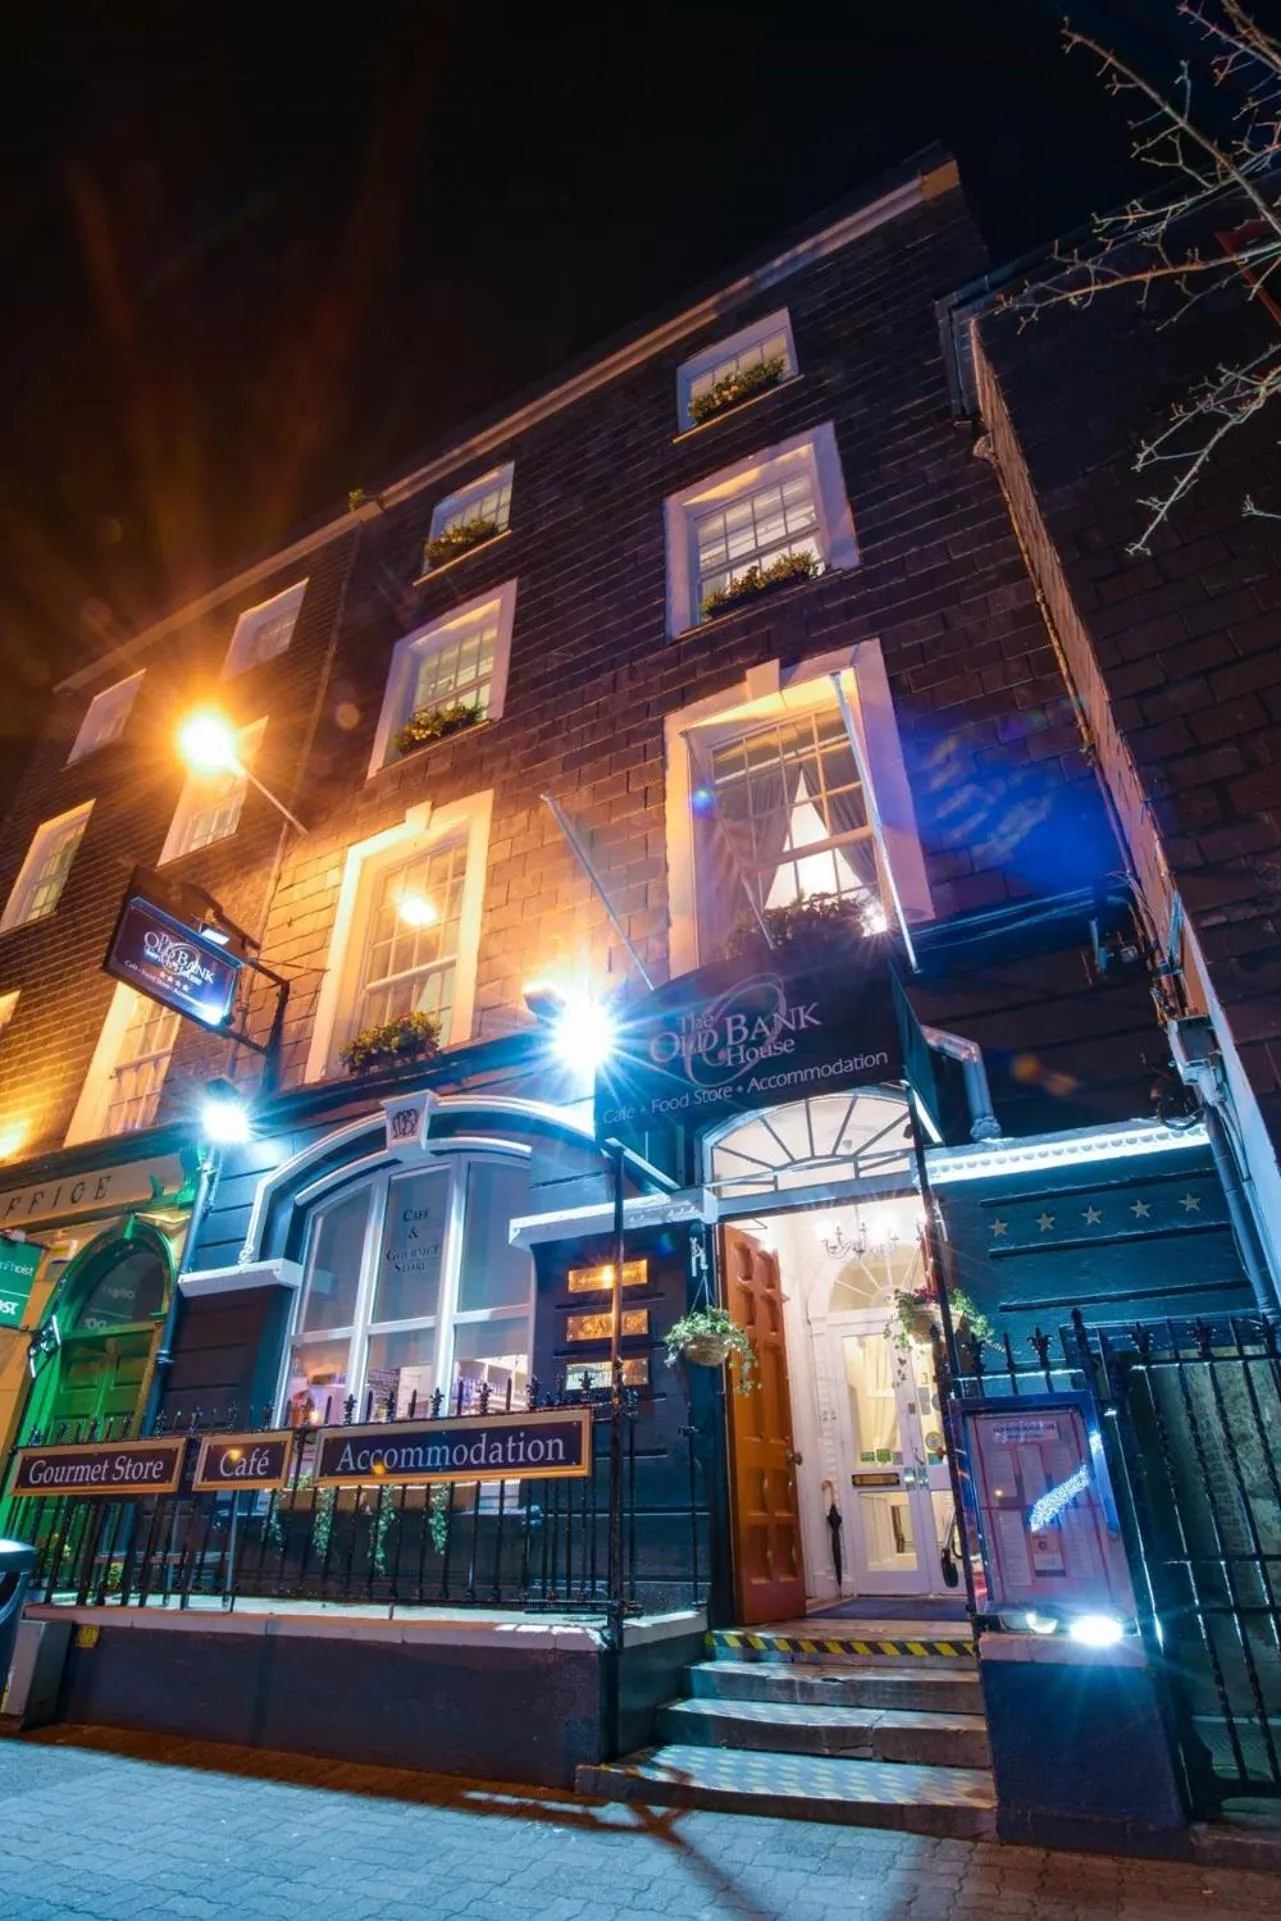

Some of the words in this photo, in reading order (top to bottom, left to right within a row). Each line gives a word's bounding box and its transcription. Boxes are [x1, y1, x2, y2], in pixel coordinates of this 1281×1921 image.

[724, 1002, 822, 1047] BANK
[727, 1037, 796, 1067] House
[651, 1092, 690, 1113] Food
[693, 1084, 733, 1104] Store
[747, 1050, 888, 1094] Accommodation
[219, 1448, 270, 1478] Café
[335, 1430, 566, 1472] Accommodation
[28, 1456, 109, 1485] Gourmet
[112, 1454, 165, 1482] Store
